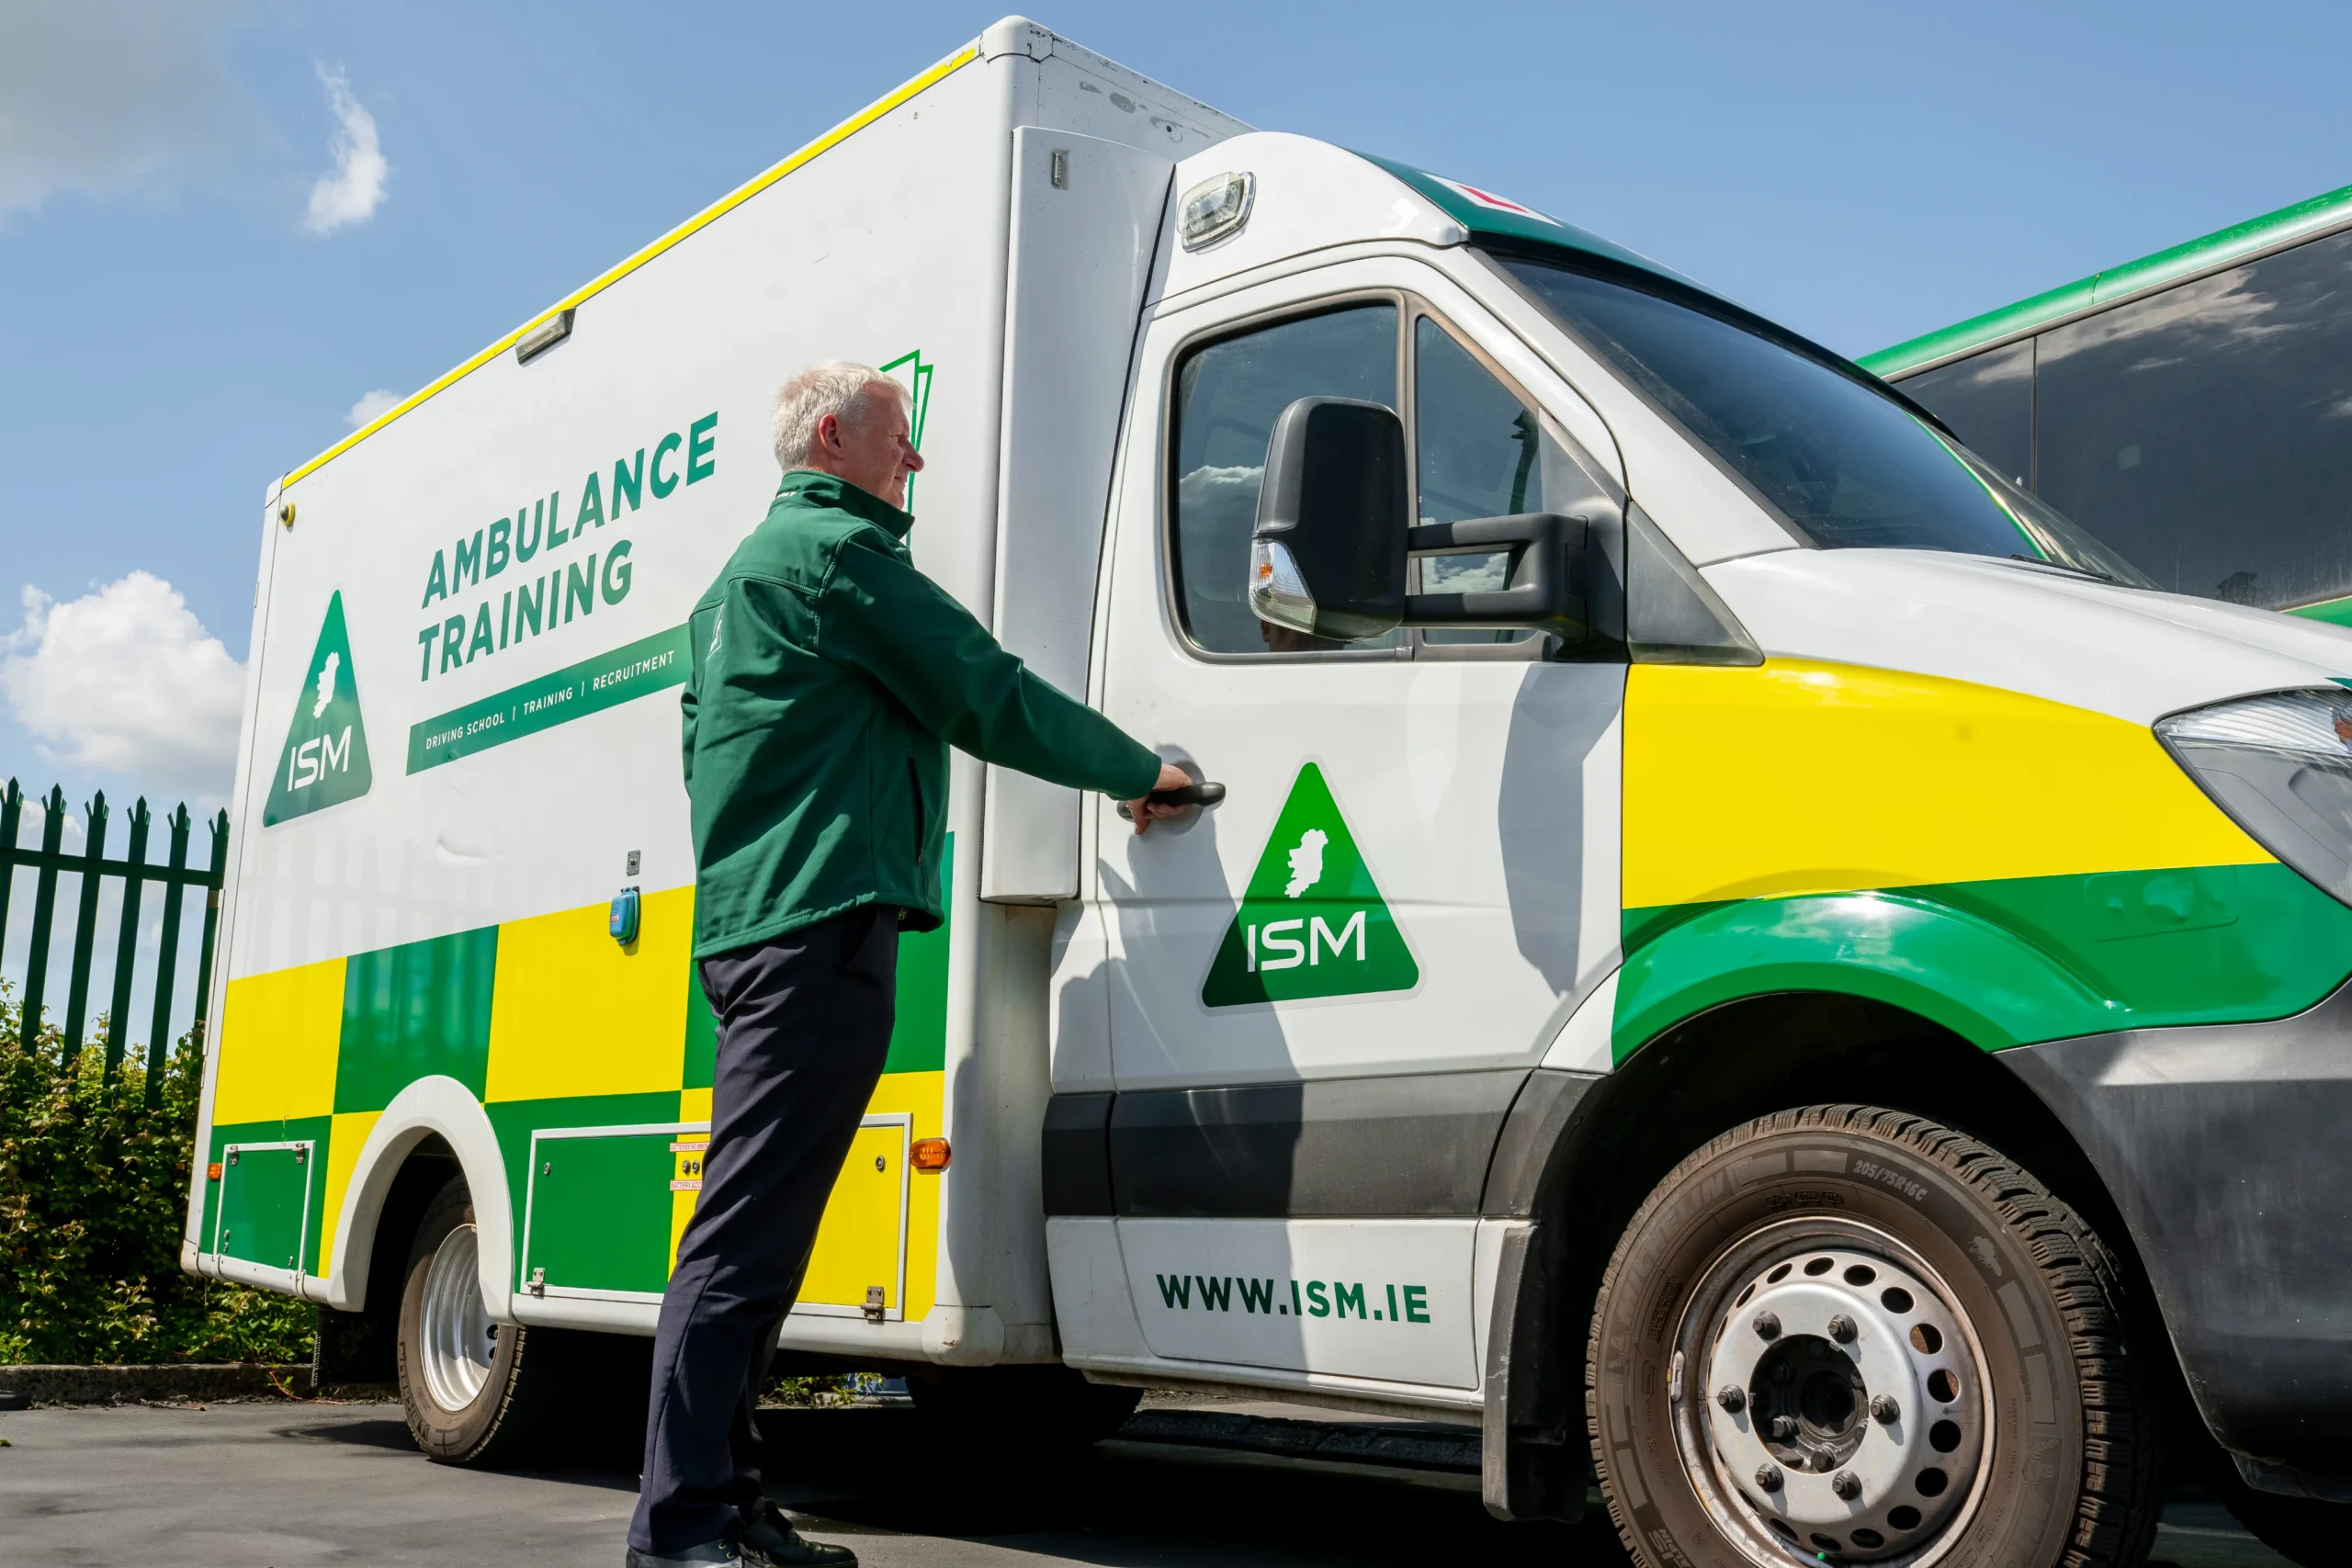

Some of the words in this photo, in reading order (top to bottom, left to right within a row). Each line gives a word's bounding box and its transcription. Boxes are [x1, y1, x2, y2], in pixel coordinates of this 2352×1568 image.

[424, 411, 718, 609] AMBULANCE
[419, 539, 632, 682] TRAINING
[425, 726, 463, 750] DRIVING
[467, 712, 504, 736] SCHOOL
[524, 687, 573, 716] TRAINING
[593, 650, 674, 691] RECRUITMENT
[287, 725, 352, 792] ISM
[1247, 911, 1366, 972] ISM
[671, 1181, 691, 1190] BATTERY
[691, 1181, 702, 1190] ACC
[1853, 1159, 1928, 1201] 205/75R16C
[1157, 1274, 1430, 1324] WWW.ISM.IE
